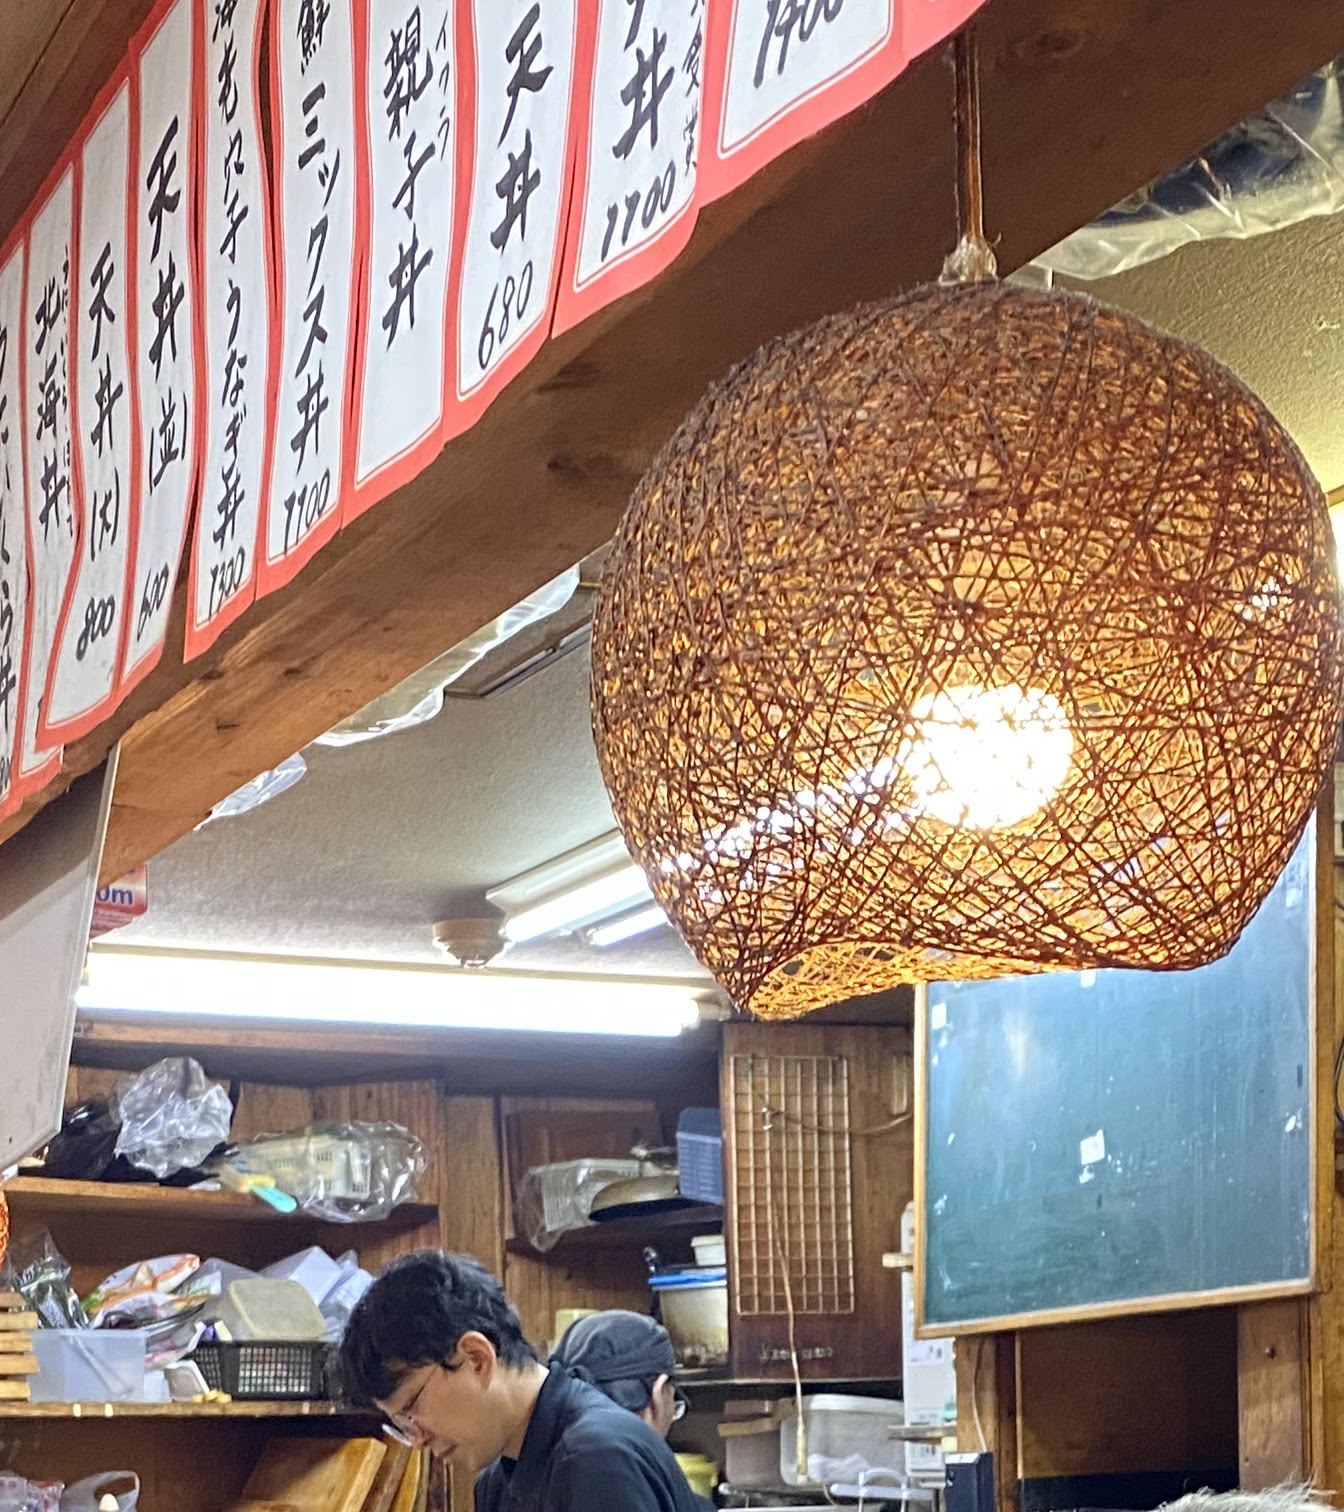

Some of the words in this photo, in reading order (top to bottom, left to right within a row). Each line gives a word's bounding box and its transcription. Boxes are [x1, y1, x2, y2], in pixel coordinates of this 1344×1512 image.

[436, 10, 451, 160] イクラ
[478, 260, 533, 370] 680
[35, 276, 66, 542] 北海丼
[76, 596, 115, 661] 800
[137, 562, 168, 642] 600
